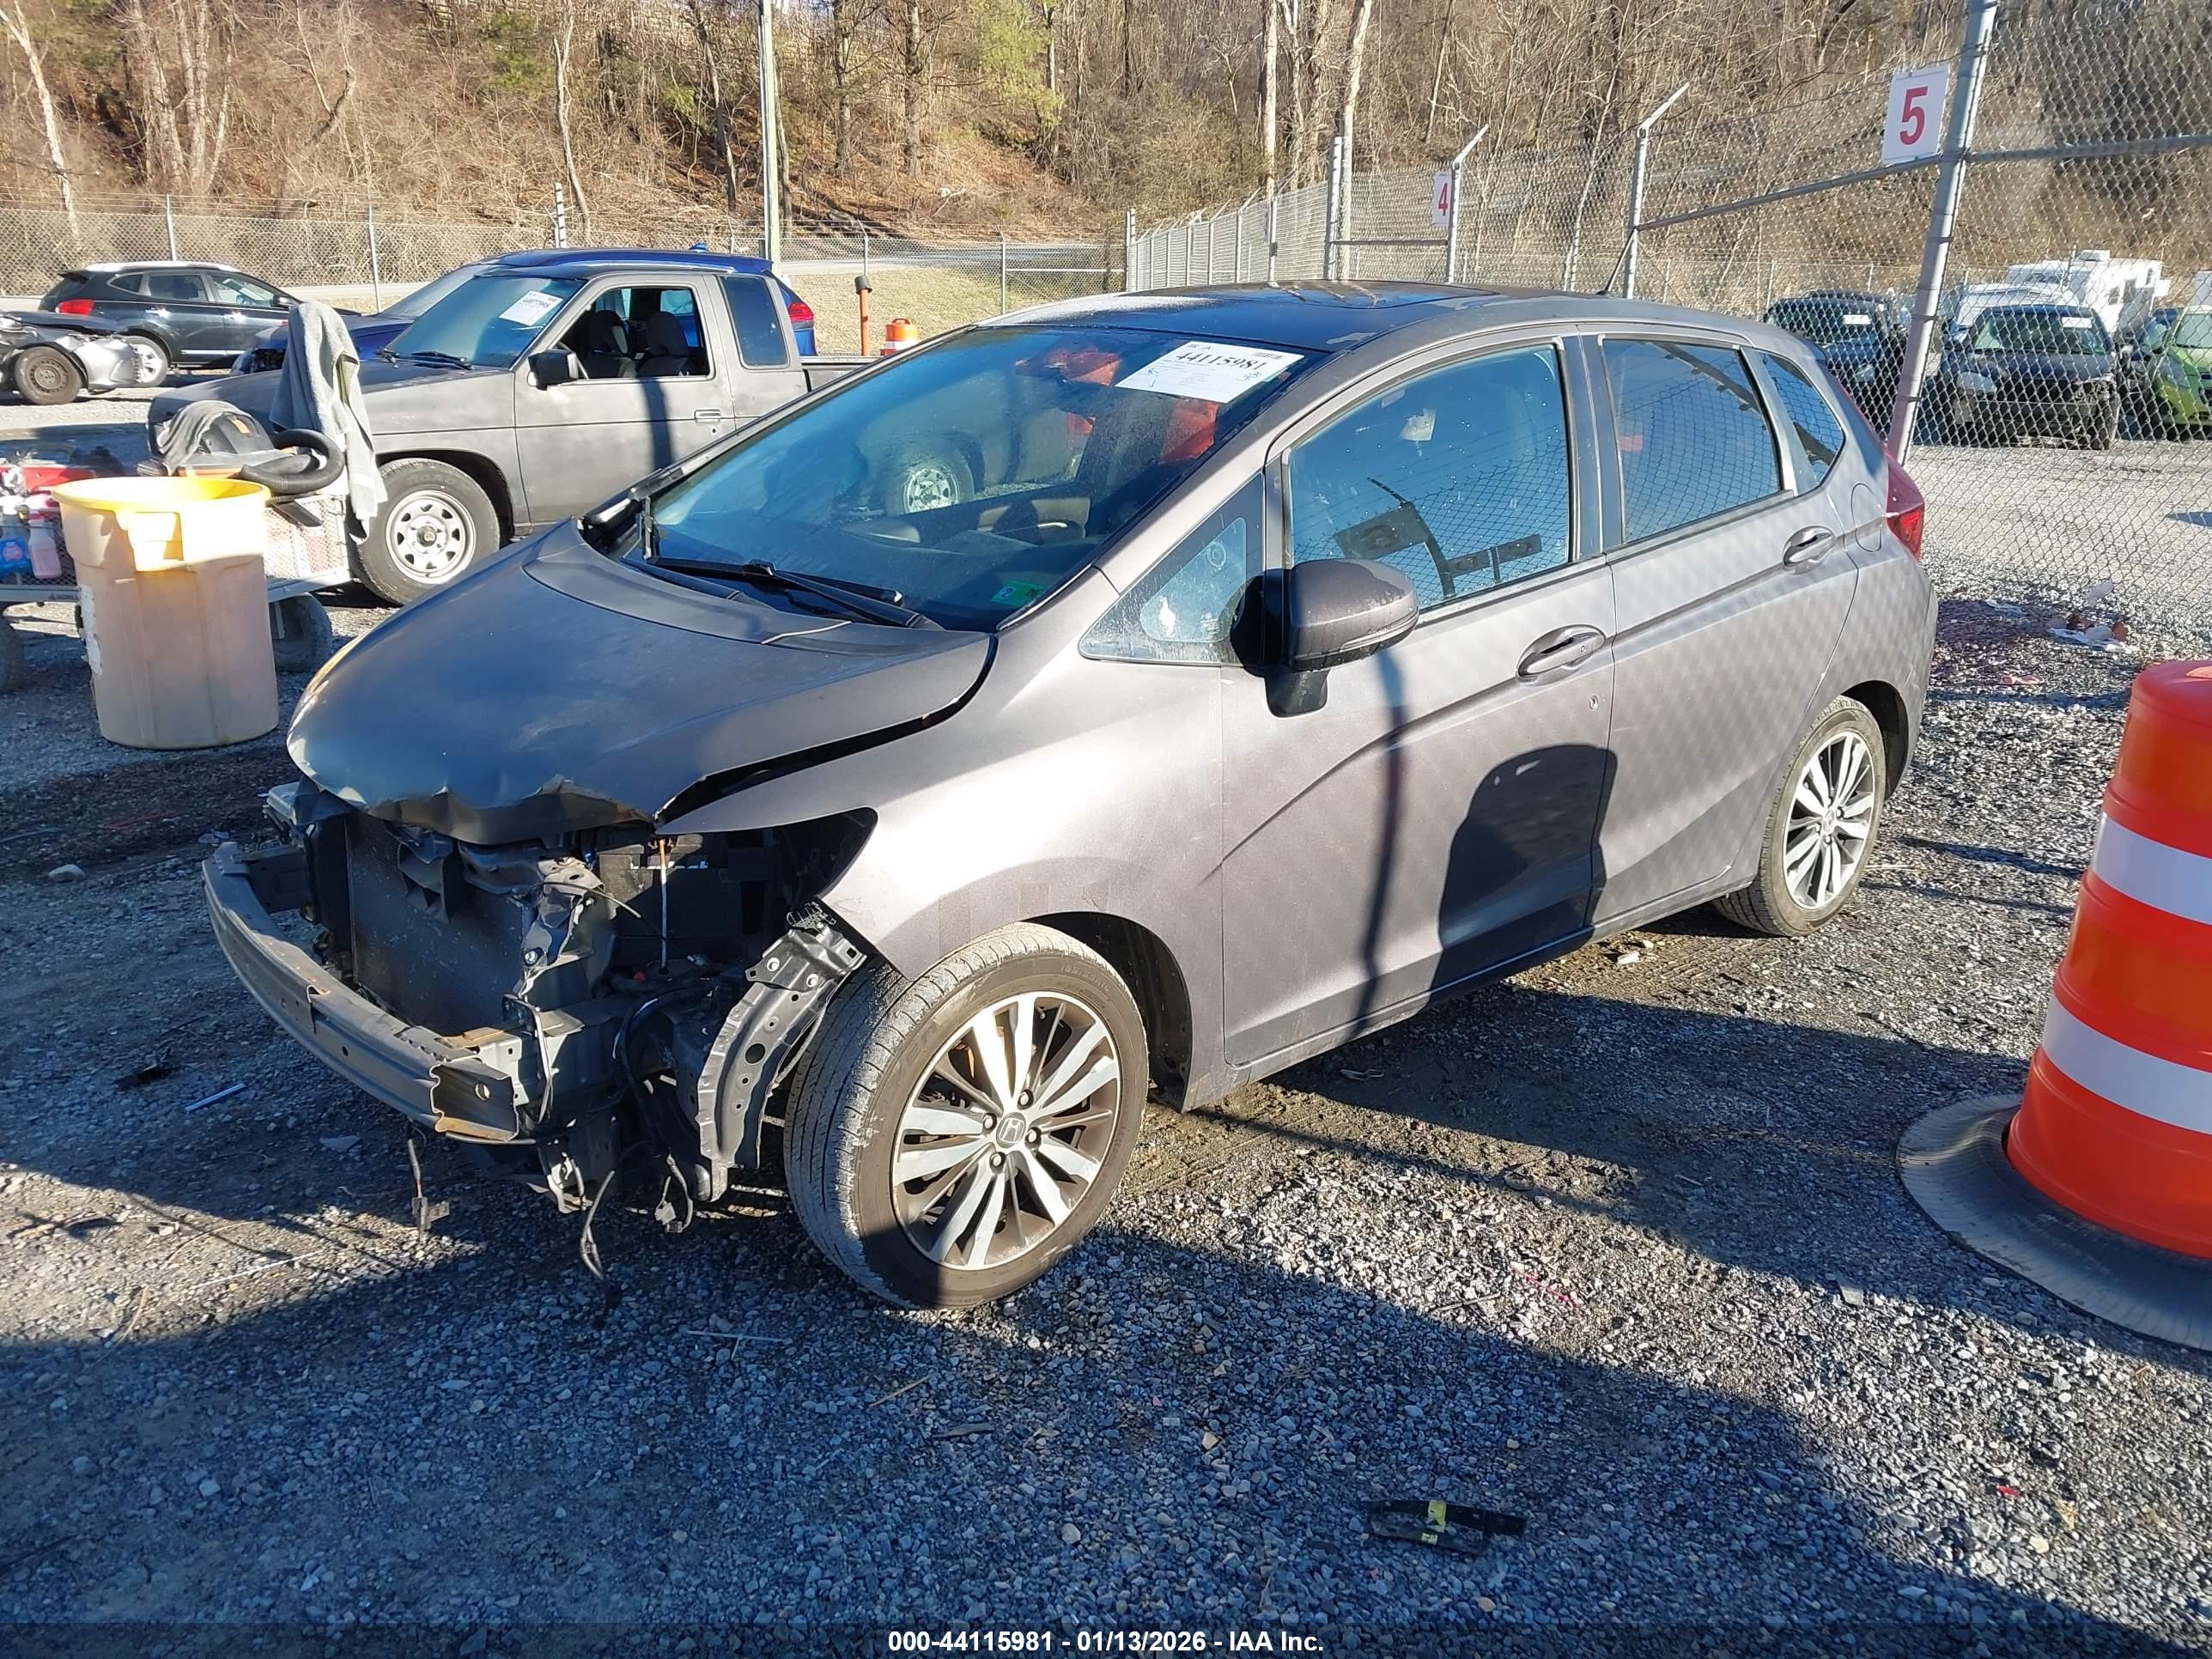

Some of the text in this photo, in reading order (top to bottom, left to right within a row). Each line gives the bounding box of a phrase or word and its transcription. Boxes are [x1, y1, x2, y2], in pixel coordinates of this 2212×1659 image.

[1899, 86, 1929, 145] 5
[1437, 182, 1449, 216] 4
[1176, 351, 1267, 371] 44115981
[1000, 587, 1013, 599] 2
